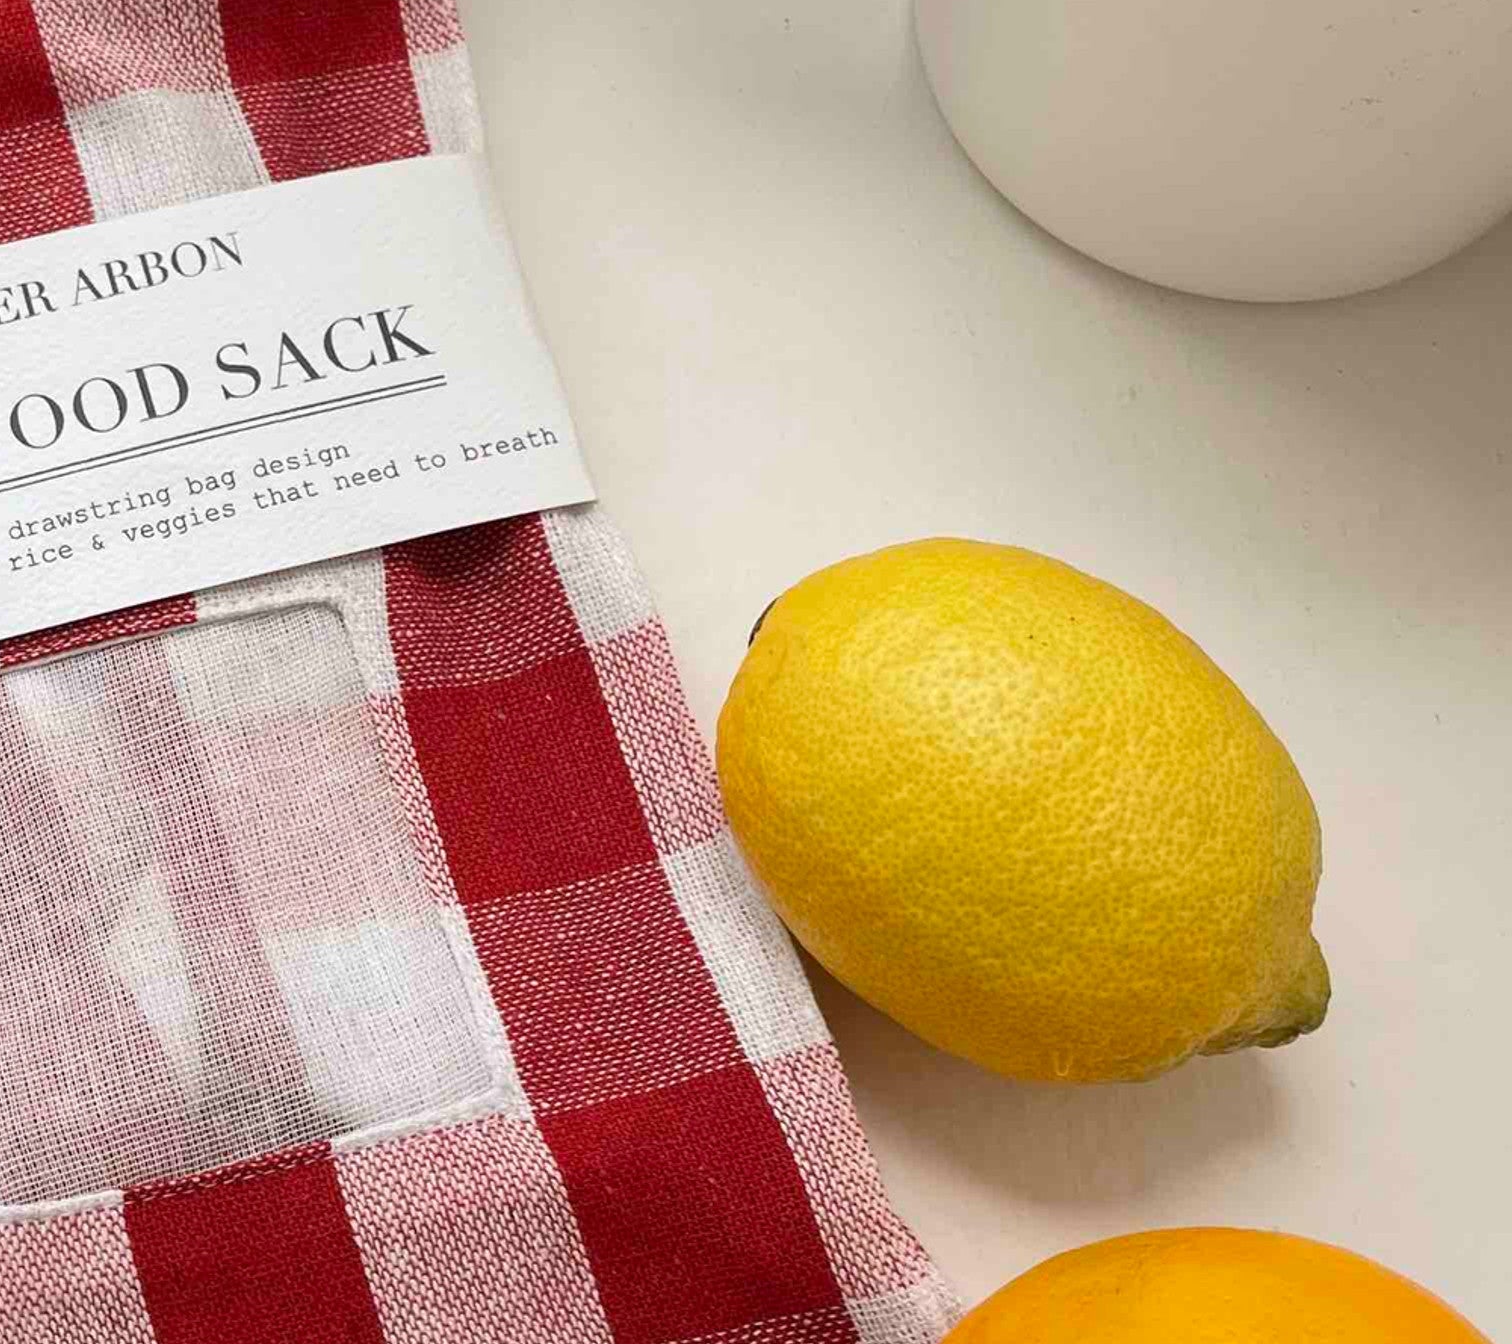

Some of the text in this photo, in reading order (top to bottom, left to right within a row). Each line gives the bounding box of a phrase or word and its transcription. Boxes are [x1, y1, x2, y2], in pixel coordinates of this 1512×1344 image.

[70, 230, 244, 308] ARBON
[214, 303, 437, 402] SACK
[7, 485, 173, 541] drawstring
[183, 469, 237, 497] bag
[251, 443, 352, 479] design
[7, 543, 75, 573] rice
[90, 532, 107, 552] &
[120, 501, 237, 543] veggies
[251, 479, 320, 511] that
[332, 458, 402, 492] need
[413, 452, 447, 473] to
[458, 426, 560, 463] breath
